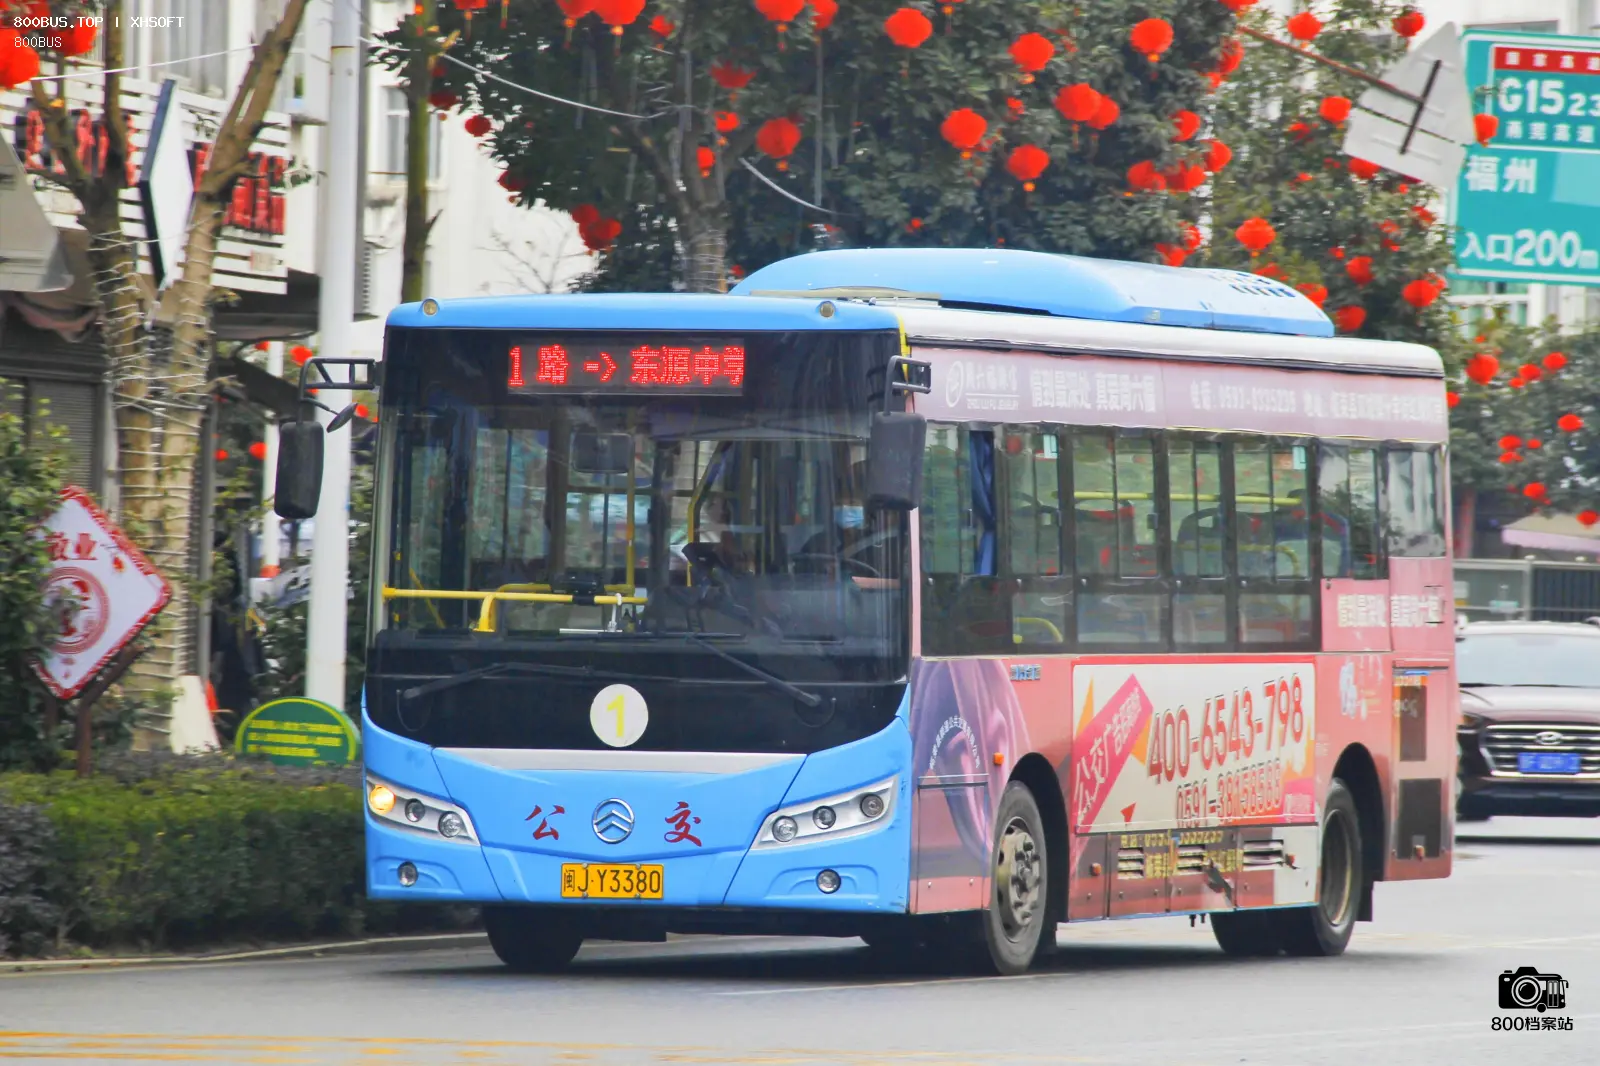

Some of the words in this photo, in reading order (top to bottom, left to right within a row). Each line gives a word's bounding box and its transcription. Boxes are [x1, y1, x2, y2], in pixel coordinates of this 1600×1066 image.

[1464, 155, 1538, 194] 福州
[508, 347, 524, 385] 1
[537, 344, 568, 385] 路
[630, 344, 744, 386] 东源中学
[606, 694, 626, 737] 1
[1148, 673, 1304, 785] 400-6543-798
[525, 804, 565, 841] 公
[664, 801, 702, 847] 交
